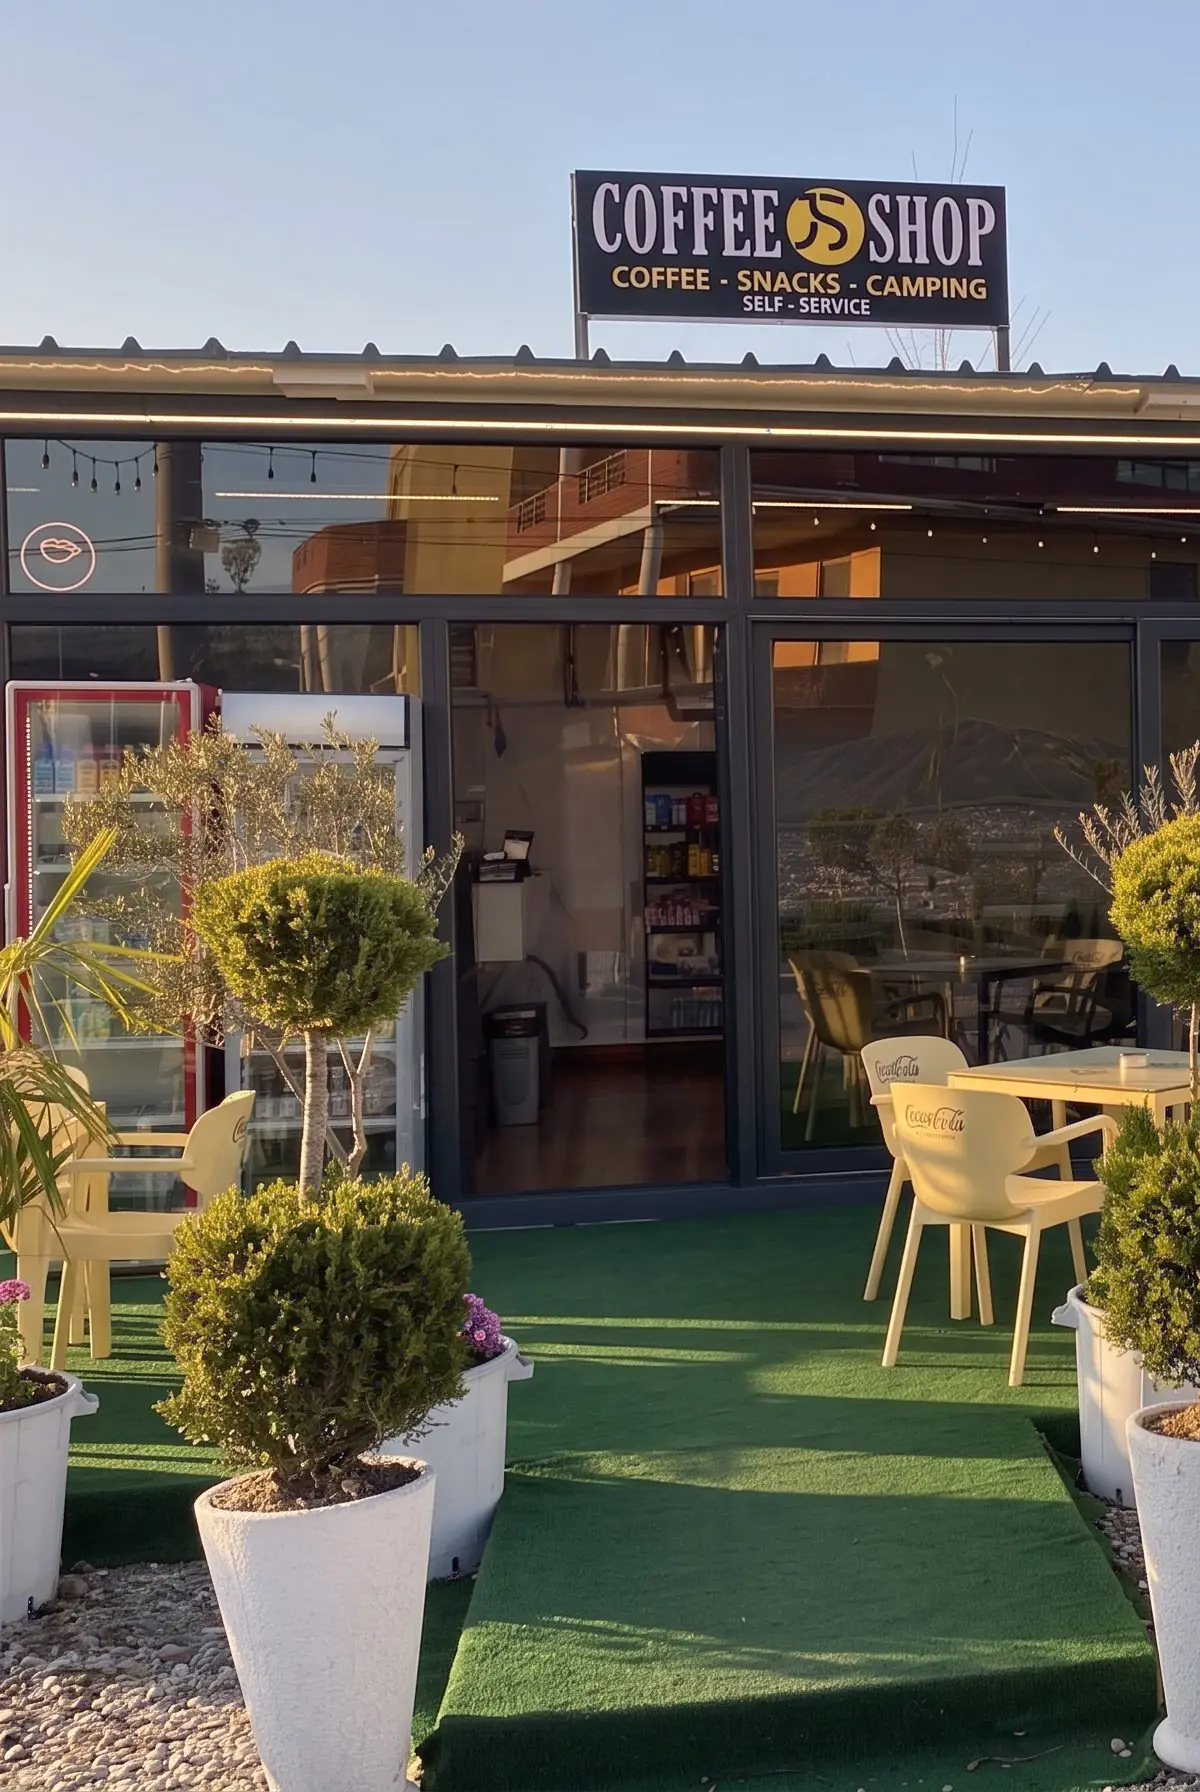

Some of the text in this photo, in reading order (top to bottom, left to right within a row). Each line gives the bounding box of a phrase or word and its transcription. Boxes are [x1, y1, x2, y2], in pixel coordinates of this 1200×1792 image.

[592, 182, 782, 258] COFFEE
[867, 193, 996, 267] SHOP
[611, 265, 711, 291] COFFEE
[737, 269, 841, 295] SNACKS
[866, 274, 988, 300] CAMPING
